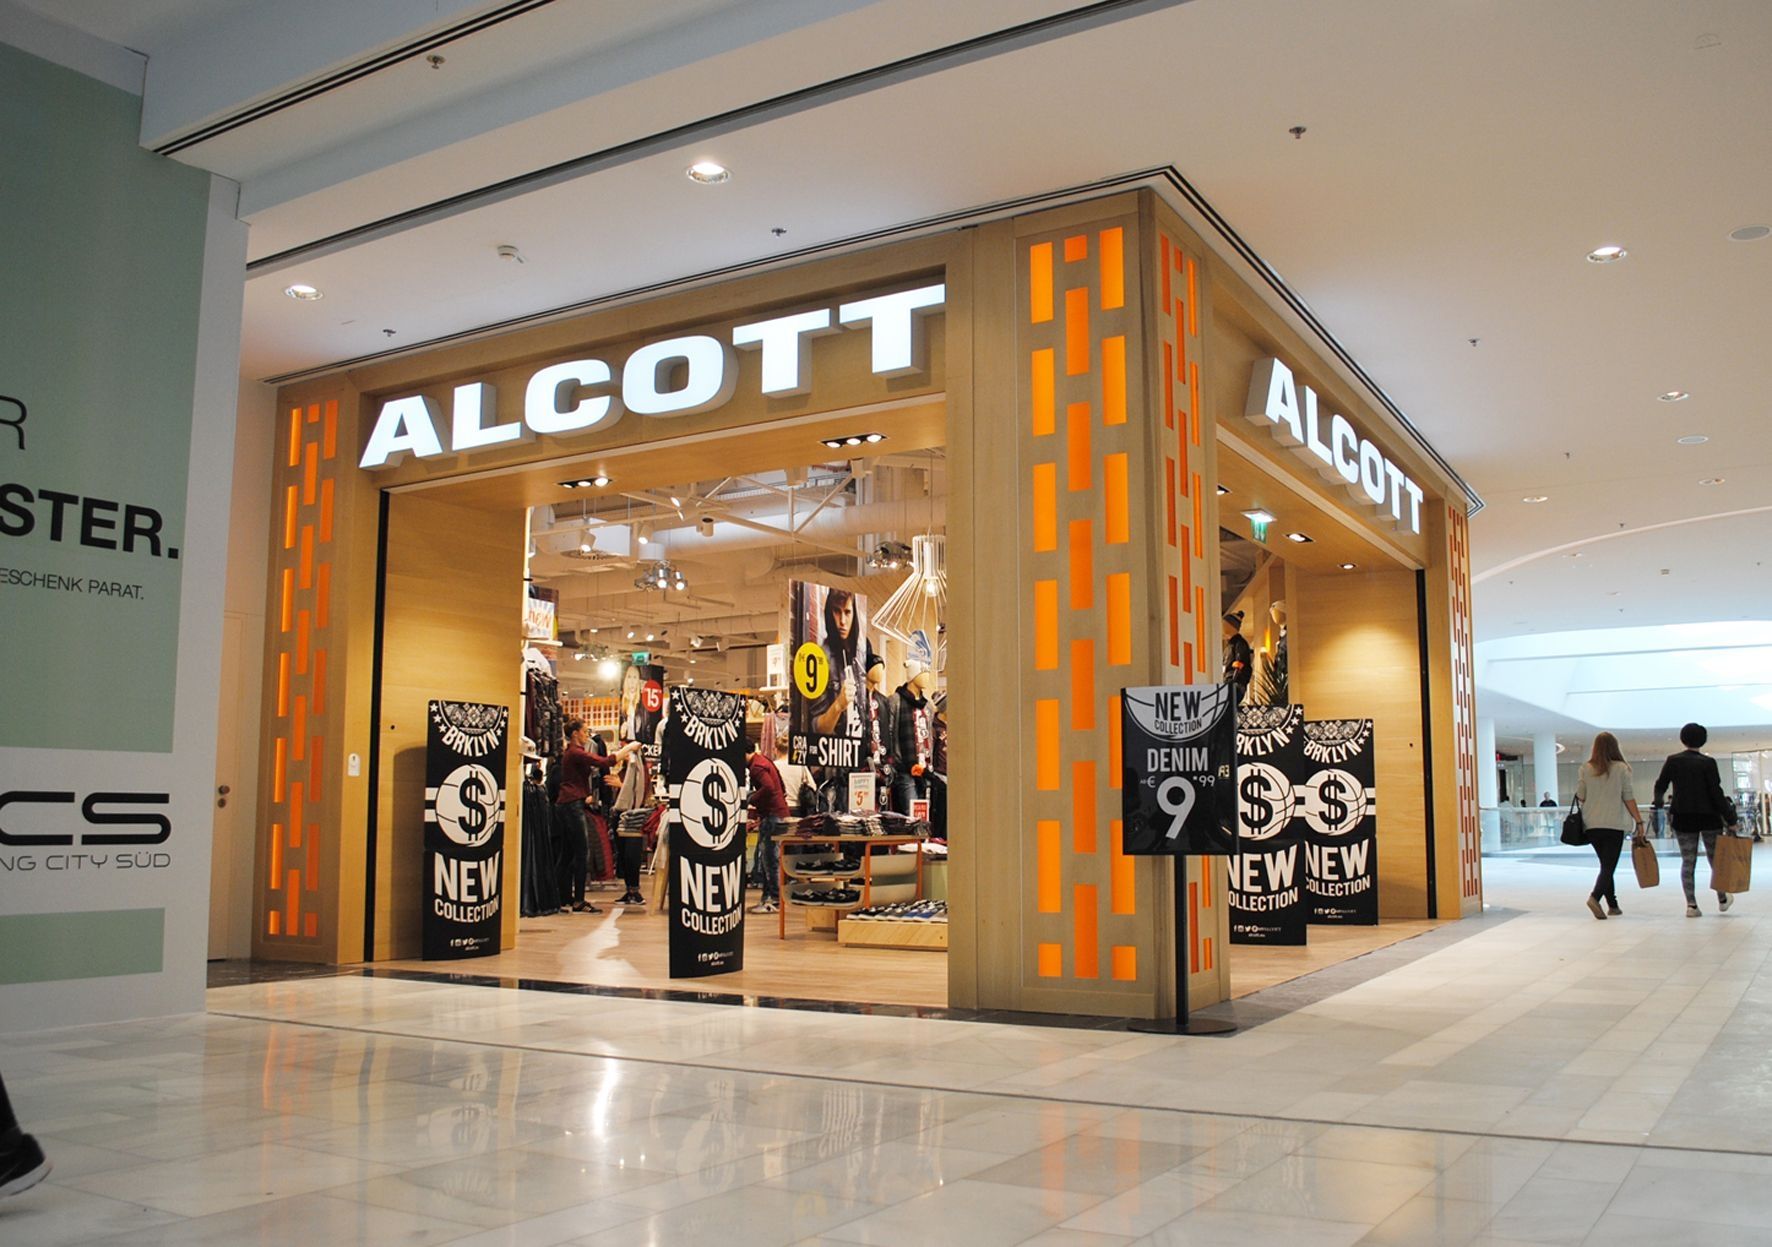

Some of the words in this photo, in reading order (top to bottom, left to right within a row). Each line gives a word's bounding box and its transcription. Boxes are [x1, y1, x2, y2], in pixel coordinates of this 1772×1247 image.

[359, 283, 946, 470] ALCOTT
[1264, 357, 1424, 535] ALCOTT
[88, 579, 145, 600] PARAT.
[1155, 691, 1202, 722] NEW
[441, 725, 501, 757] BRKLYN
[684, 714, 738, 750] BRKLYN
[1154, 717, 1203, 735] COLLECTION
[1236, 726, 1291, 756] RKLYN
[818, 736, 861, 768] SHIRT
[1147, 746, 1209, 773] DENIM
[1303, 738, 1362, 764] BRKLYN
[1156, 775, 1196, 839] 9
[46, 854, 108, 870] CITY
[116, 851, 171, 869] SÜD
[1304, 838, 1369, 880] NEW
[434, 850, 500, 903] NEW
[680, 854, 742, 913] NEW
[434, 893, 500, 924] COLLECTION
[1228, 886, 1299, 912] OLLECTION
[681, 905, 742, 935] COLLECTION
